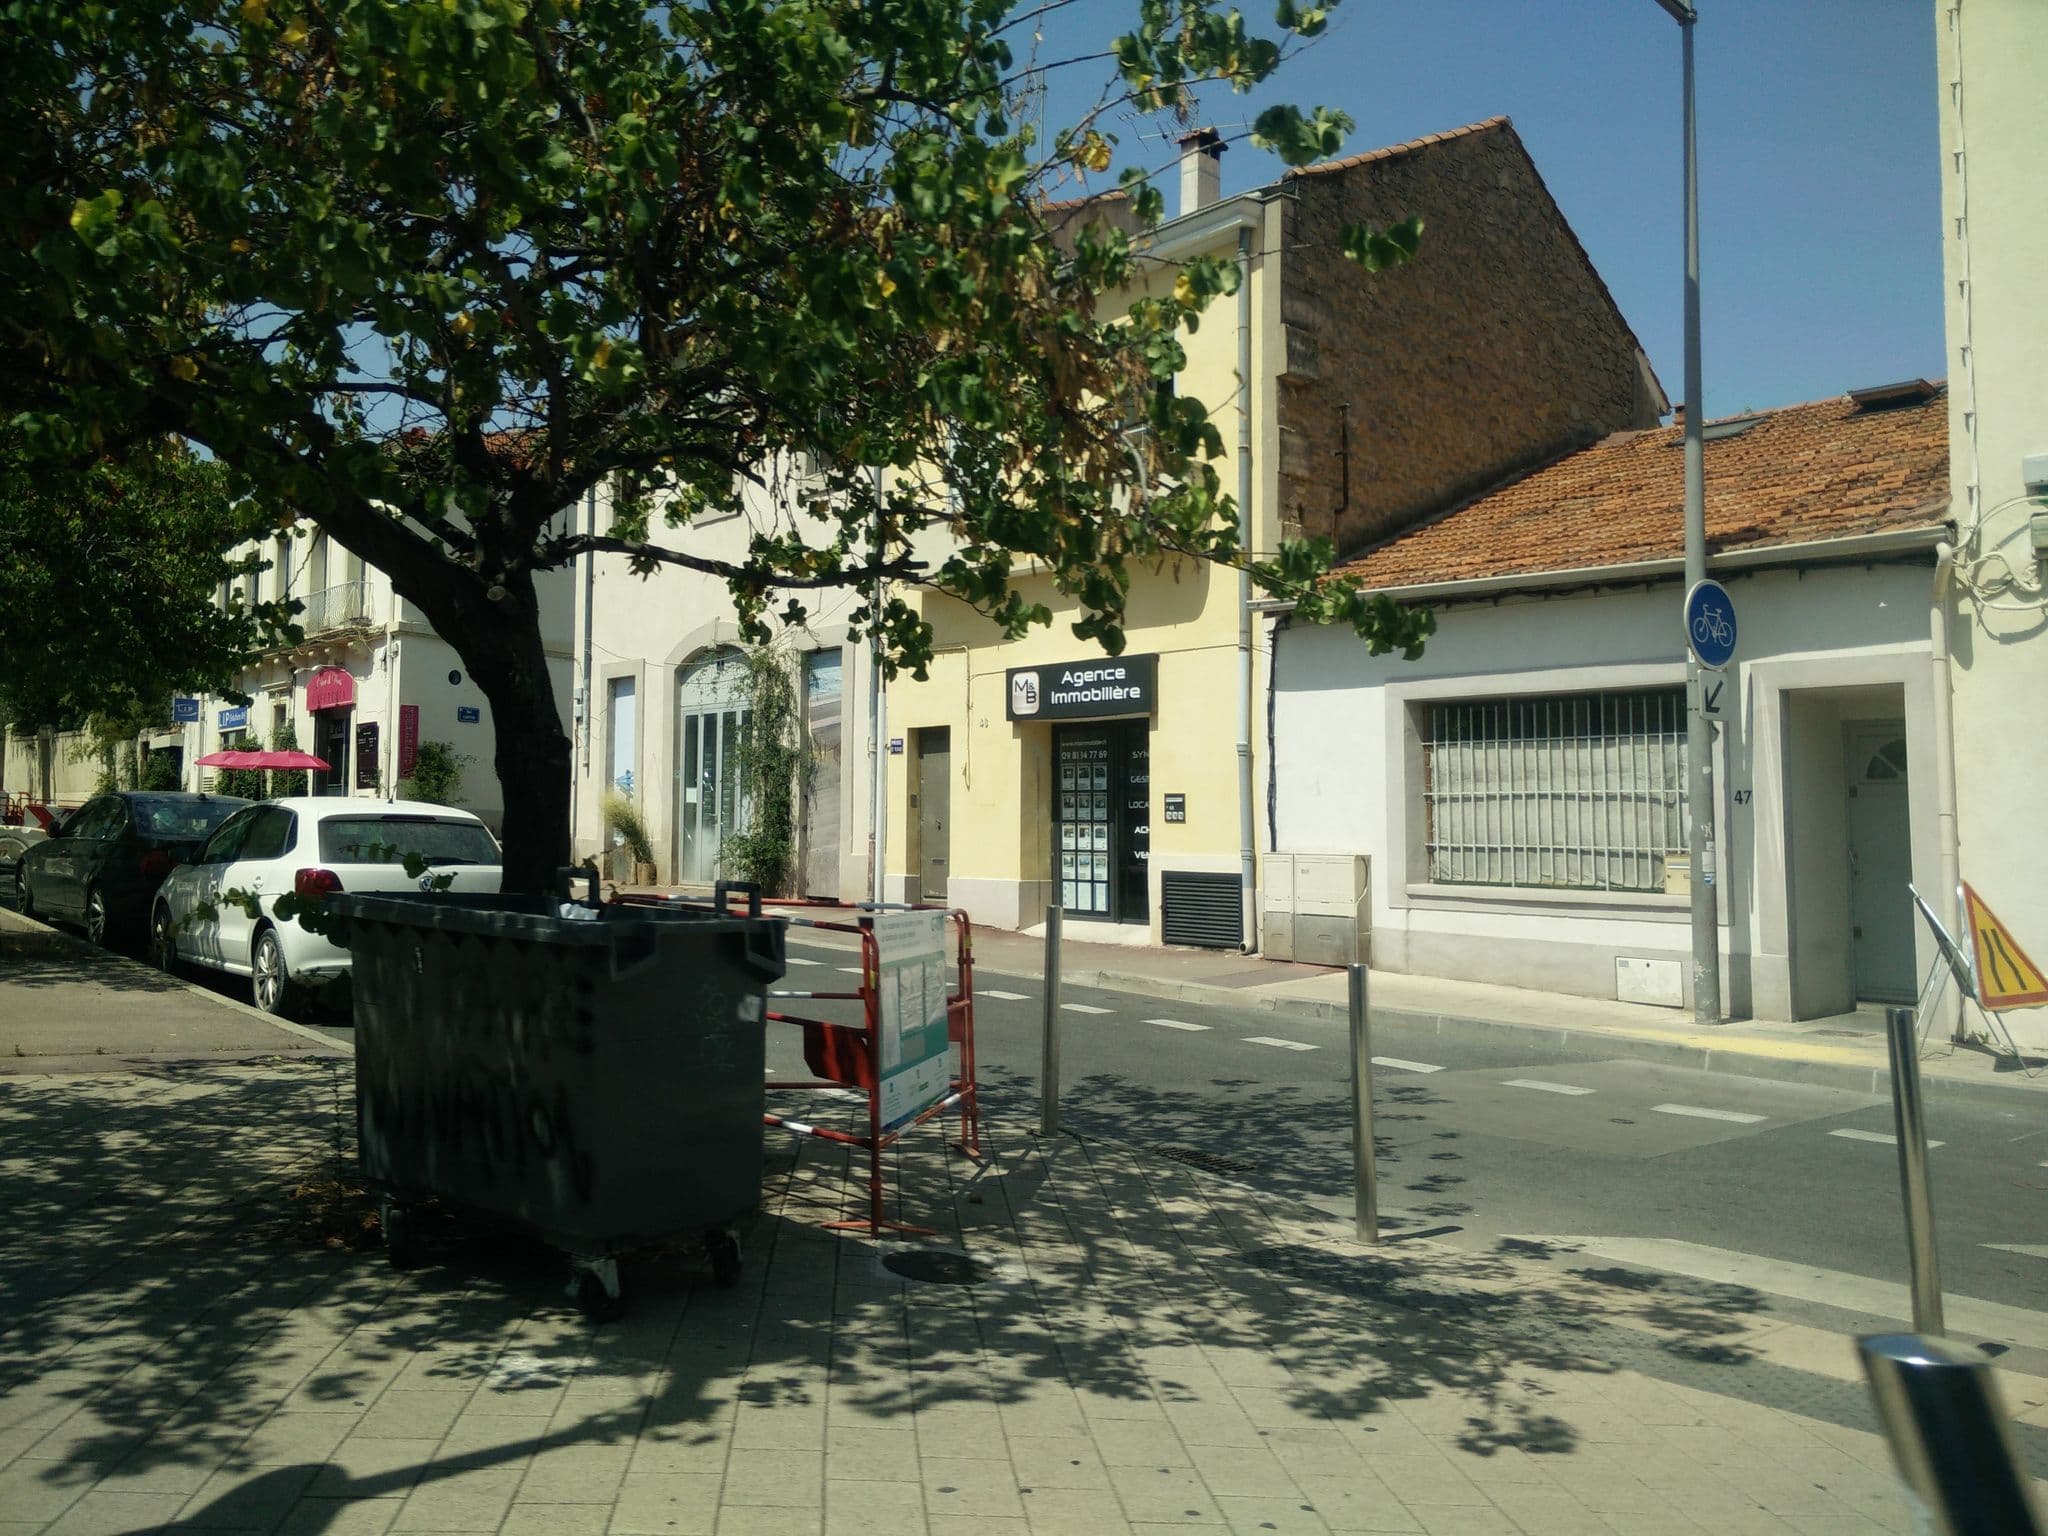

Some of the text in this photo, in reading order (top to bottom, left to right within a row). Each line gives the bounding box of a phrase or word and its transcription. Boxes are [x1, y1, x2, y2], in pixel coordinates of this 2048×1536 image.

[1061, 668, 1126, 687] Agence
[1051, 685, 1141, 704] Immobilière
[1061, 751, 1071, 760] 09
[1089, 750, 1098, 759] 77
[1098, 749, 1108, 759] 69
[1734, 789, 1753, 805] 47
